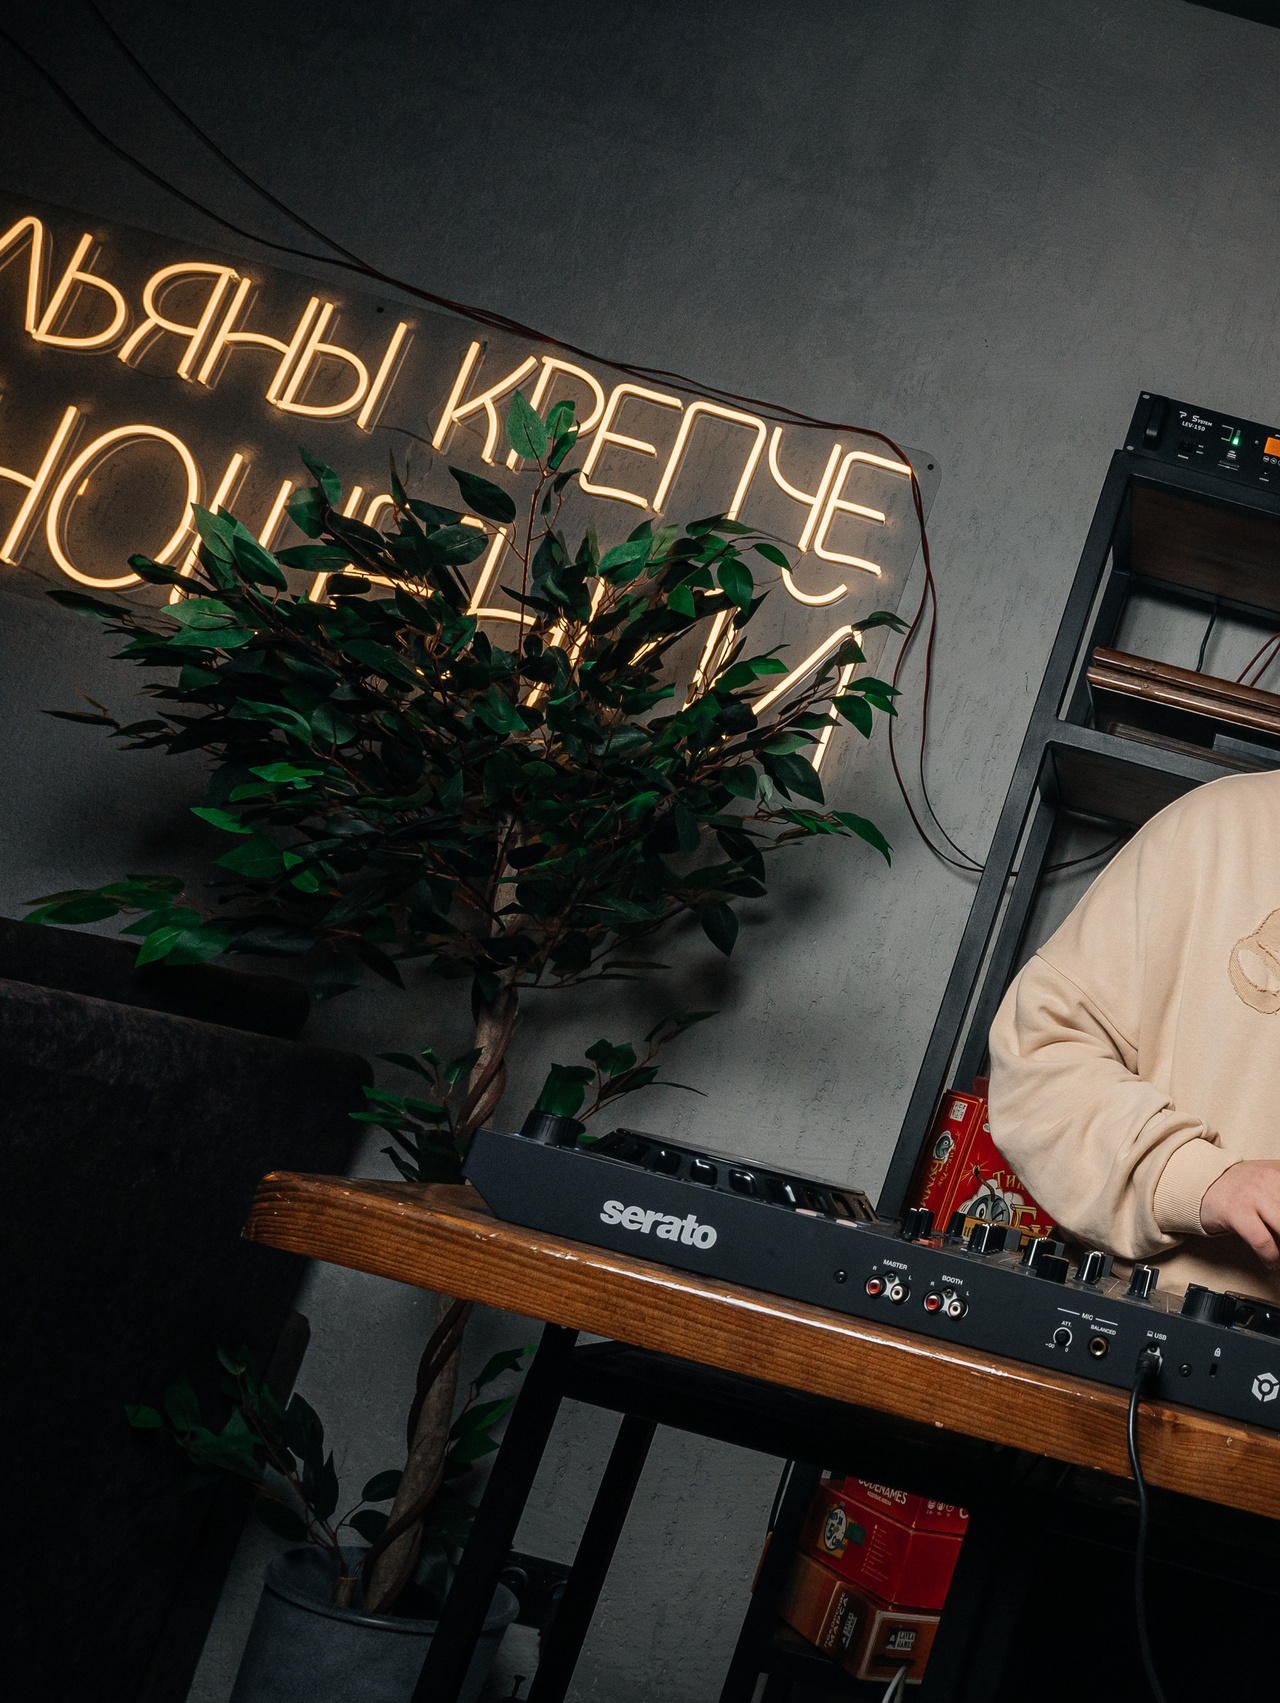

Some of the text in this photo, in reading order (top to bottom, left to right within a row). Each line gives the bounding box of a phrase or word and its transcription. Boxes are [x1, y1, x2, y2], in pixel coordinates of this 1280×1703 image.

[432, 340, 914, 577] КРЕПЧЕ
[600, 1199, 717, 1251] serato
[882, 1259, 908, 1271] MASTER
[941, 1274, 964, 1286] BOOTH
[1081, 1312, 1094, 1321] MIC
[1061, 1320, 1117, 1336] ATT. BALANCED
[1153, 1332, 1168, 1341] USB
